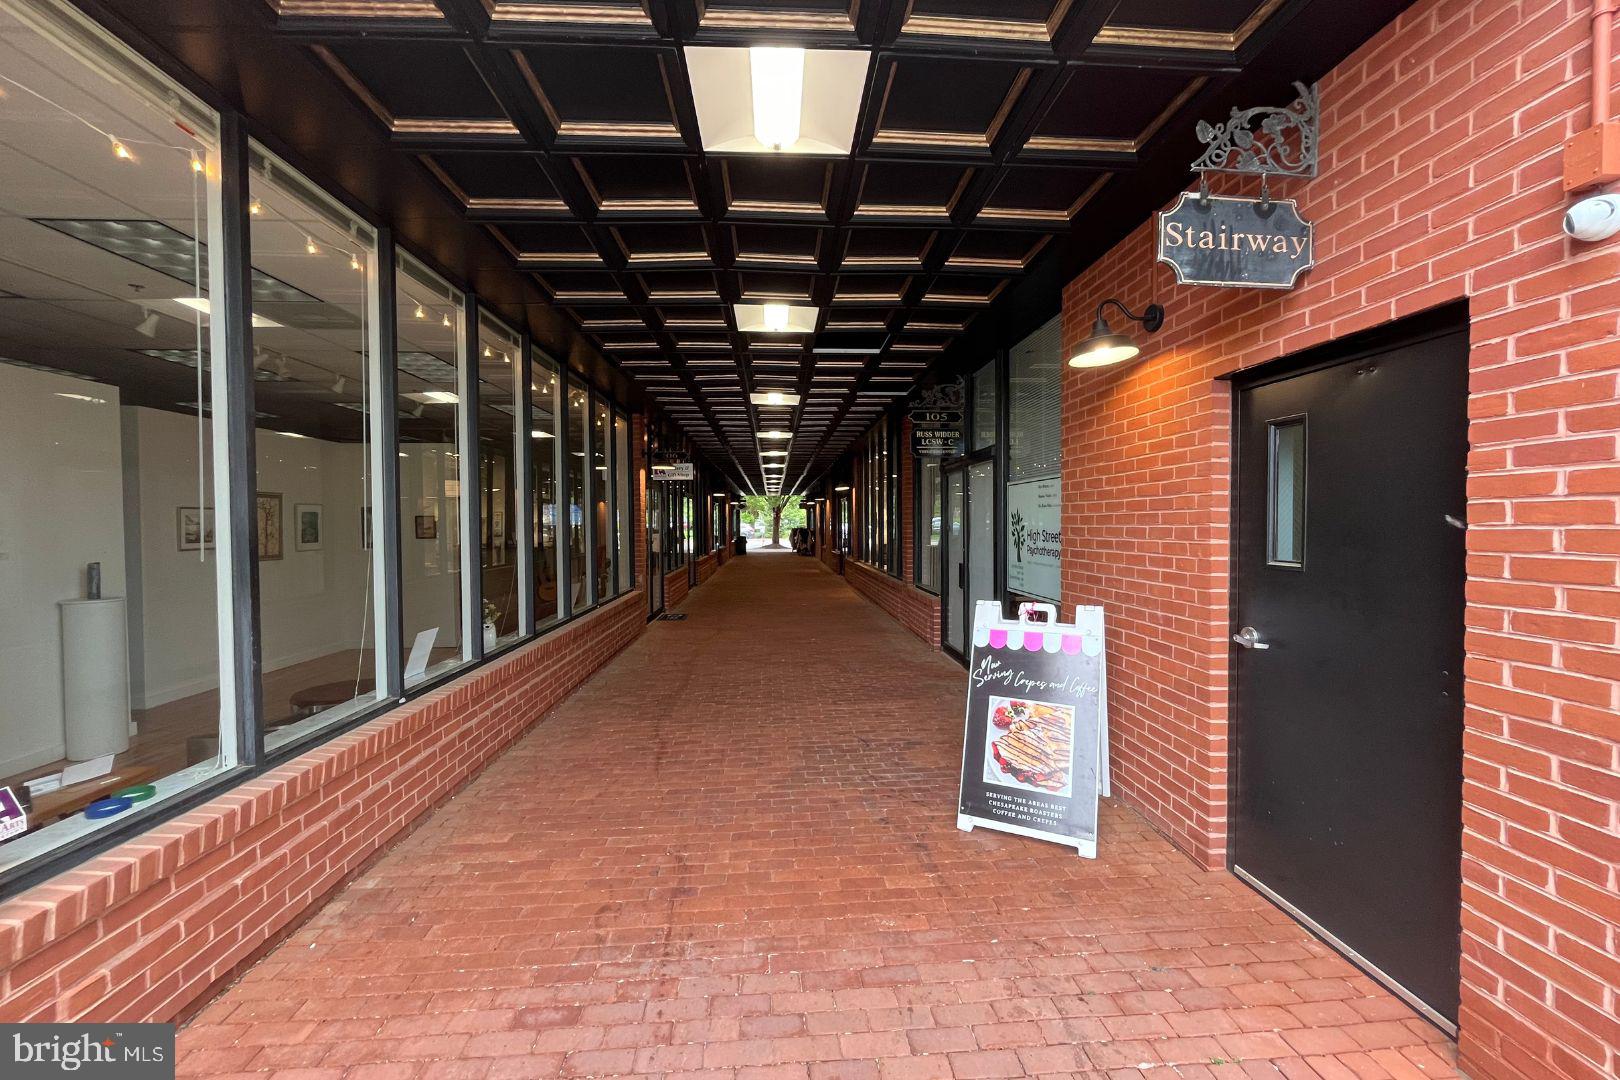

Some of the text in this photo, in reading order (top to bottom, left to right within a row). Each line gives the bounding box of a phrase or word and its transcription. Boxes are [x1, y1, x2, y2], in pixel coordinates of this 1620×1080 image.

[1165, 222, 1308, 259] Stairway
[926, 412, 948, 421] 105
[1026, 529, 1062, 545] High Street
[1026, 544, 1061, 560] Psychotherapy
[972, 668, 1098, 698] Serving Crepes and Coffee
[985, 791, 1012, 801] SERVING
[1027, 800, 1049, 809] AREAS
[1050, 804, 1067, 812] BEST
[988, 799, 1063, 819] CHESAPEAKE ROASTERS
[992, 808, 1057, 826] COFFEE AND CREPES
